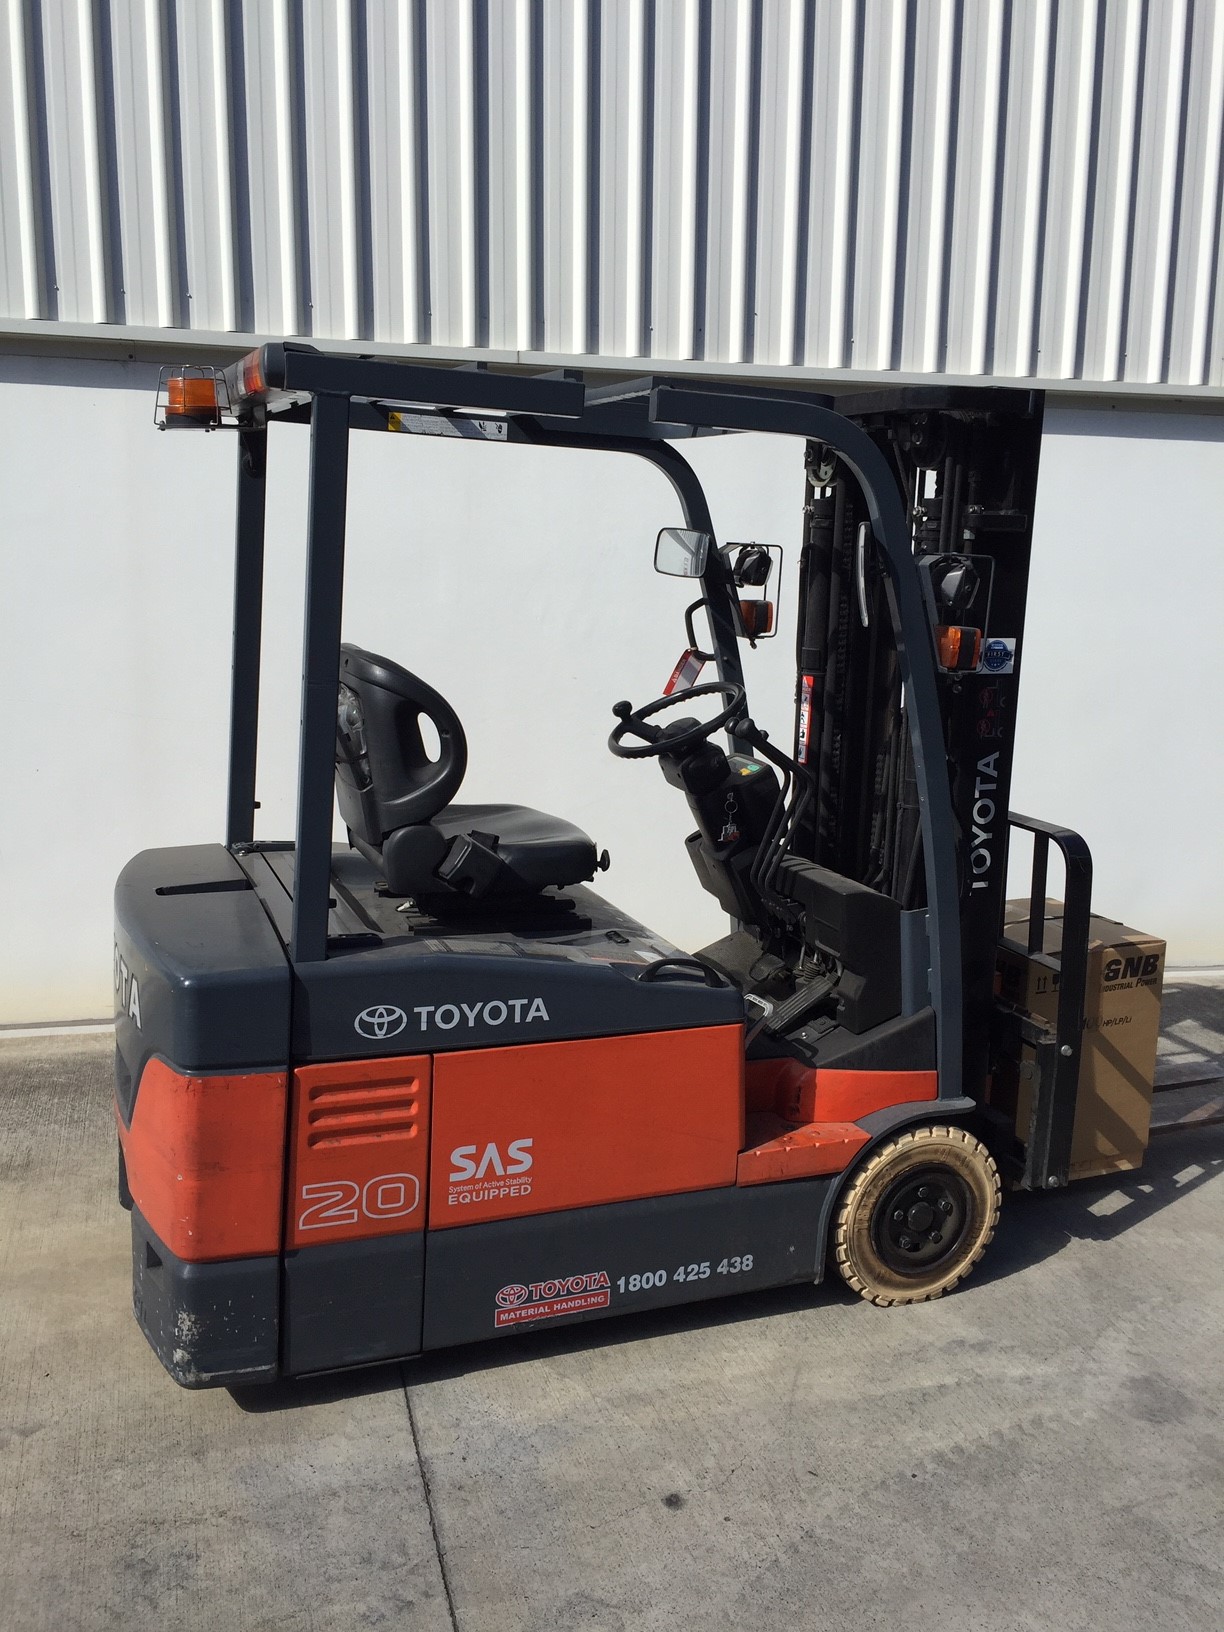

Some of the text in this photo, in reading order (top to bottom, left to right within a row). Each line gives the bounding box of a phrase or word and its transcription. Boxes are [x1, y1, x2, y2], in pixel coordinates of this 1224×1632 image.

[1104, 954, 1160, 982] GNB
[413, 997, 550, 1032] TOYOTA
[449, 1137, 533, 1183] SAS
[448, 1177, 532, 1194] System of Active Stability
[448, 1185, 532, 1205] EQUIPPED
[299, 1173, 420, 1230] 20
[529, 1254, 754, 1301] TOYOTA 1800 425 438
[500, 1295, 605, 1321] MATERIAL HANDLING
